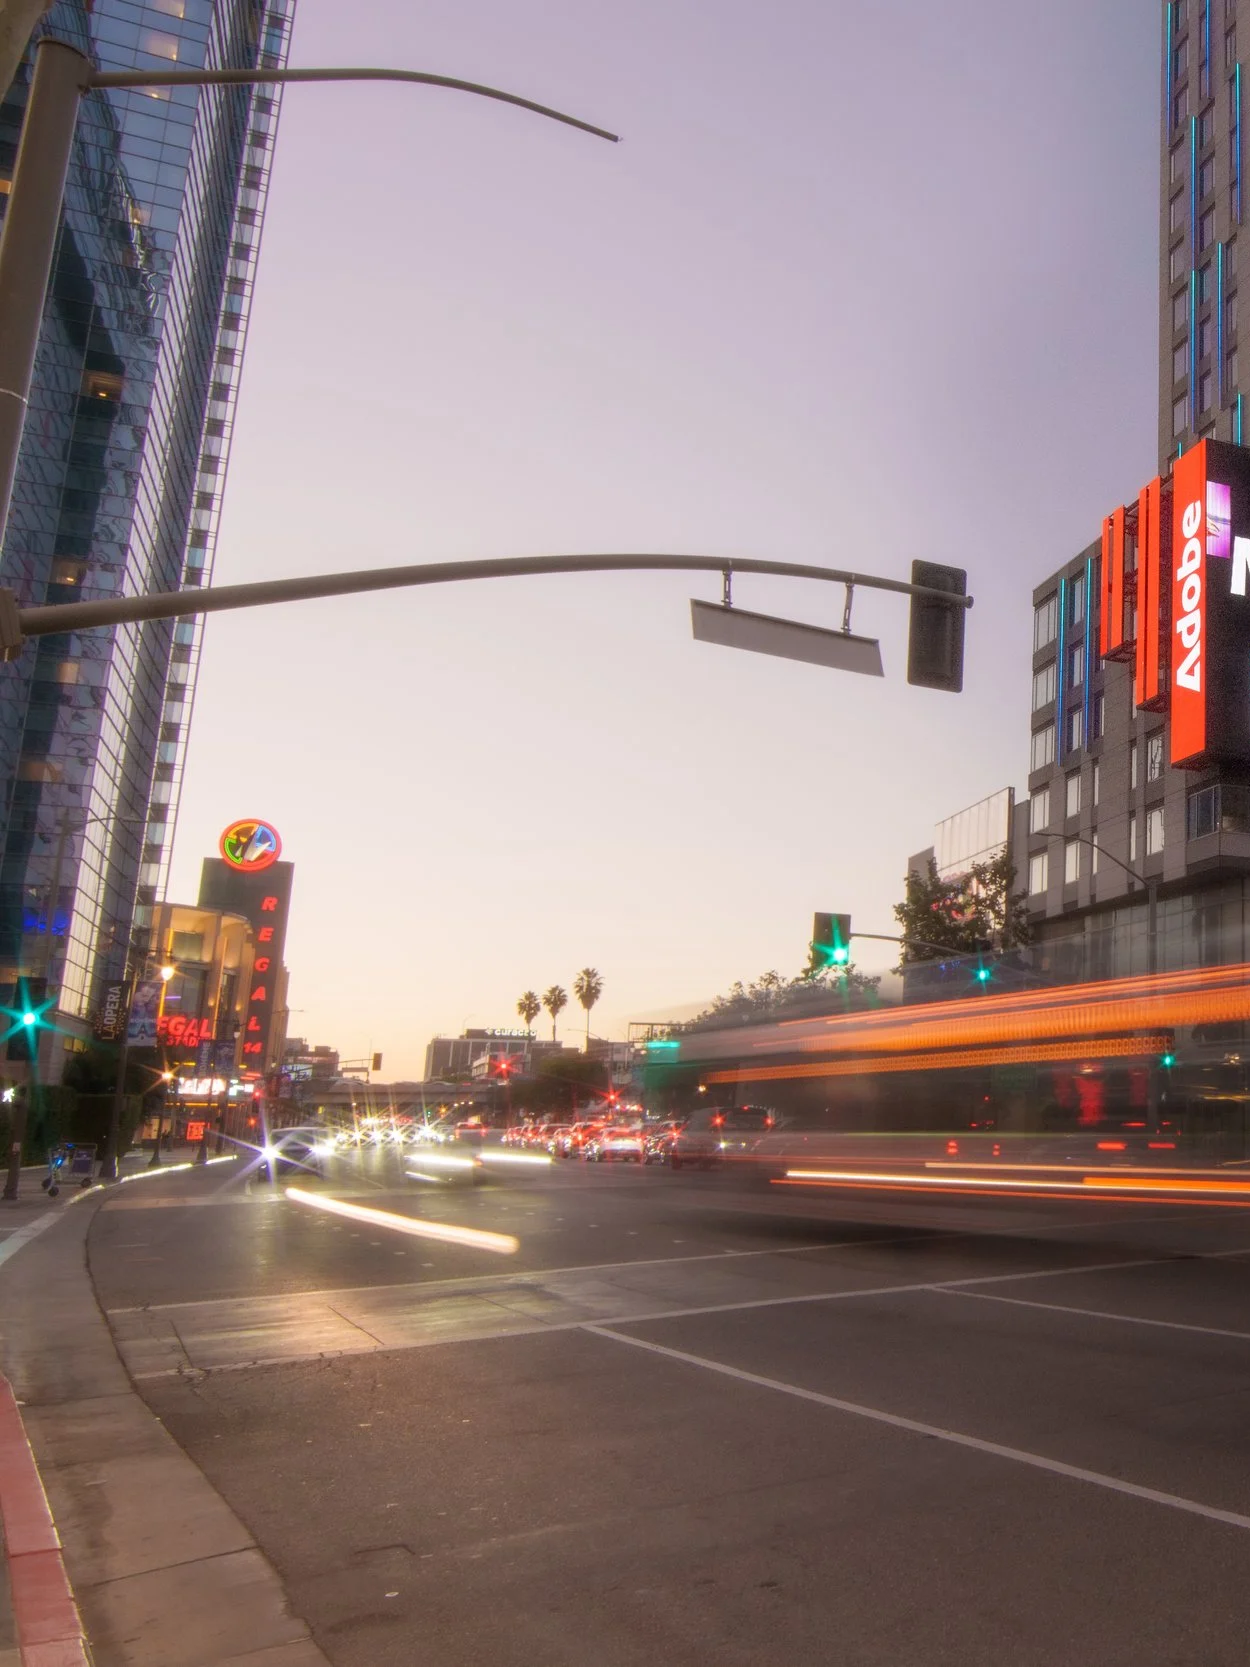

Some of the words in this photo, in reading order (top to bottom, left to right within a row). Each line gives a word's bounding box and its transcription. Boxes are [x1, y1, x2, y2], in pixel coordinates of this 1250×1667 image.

[1176, 500, 1201, 692] Adobe
[247, 896, 278, 1031] REGAL
[157, 1015, 212, 1037] EGAL
[243, 1042, 263, 1054] 14
